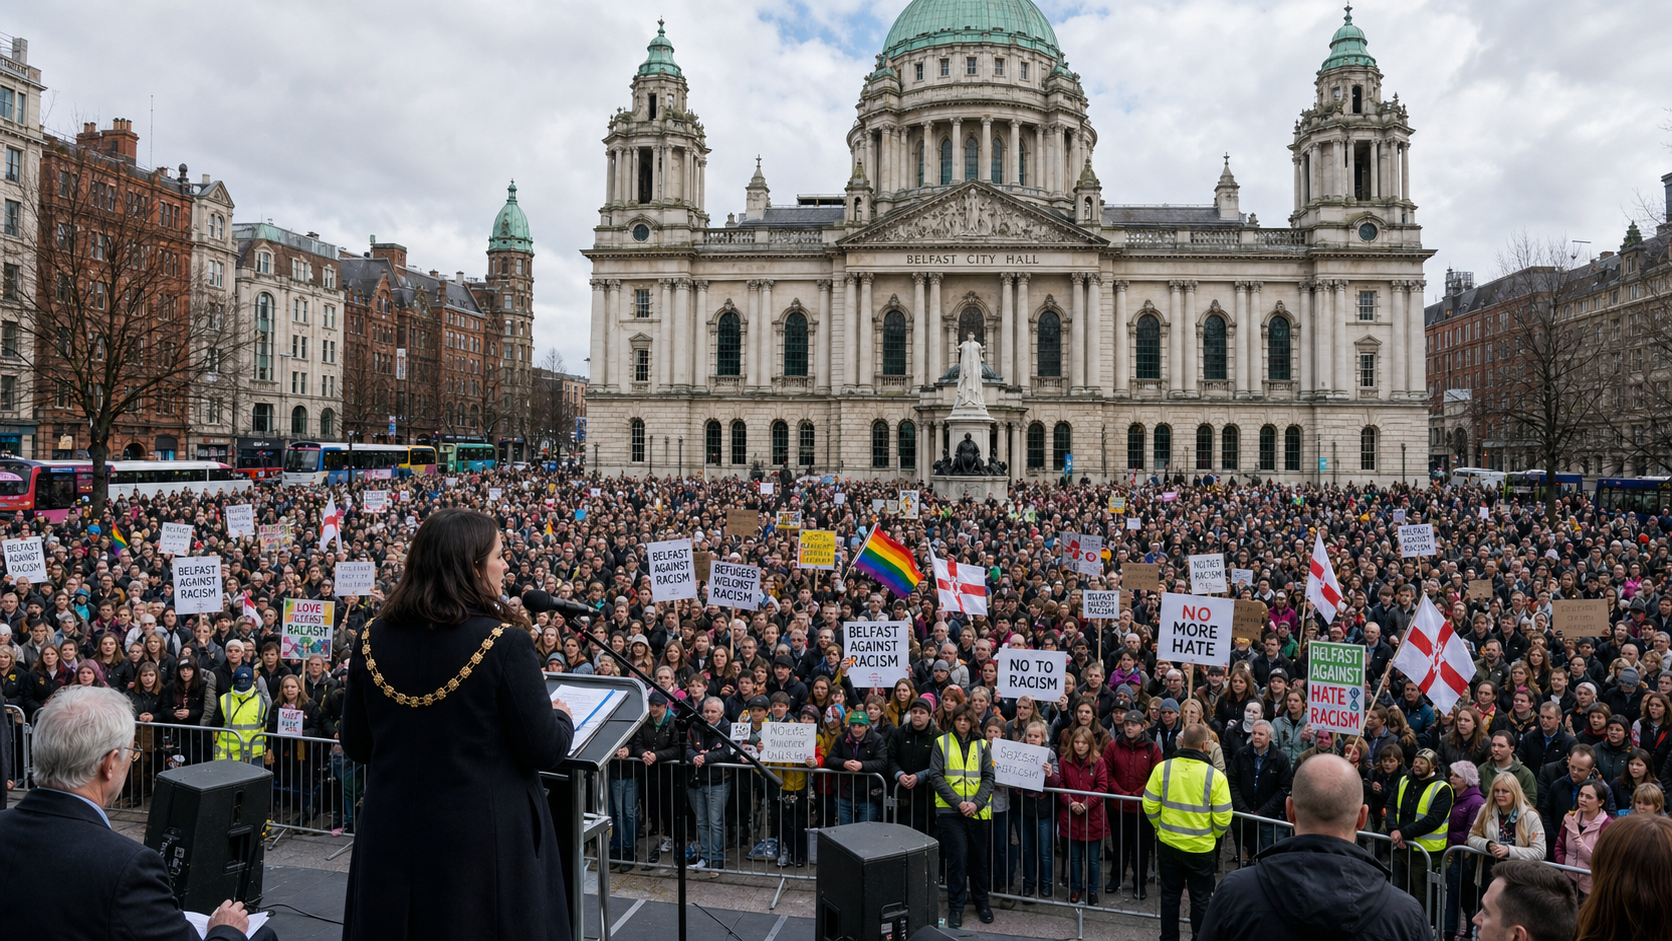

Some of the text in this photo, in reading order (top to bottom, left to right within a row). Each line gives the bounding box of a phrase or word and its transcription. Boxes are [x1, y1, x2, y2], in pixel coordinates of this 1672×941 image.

[906, 254, 1039, 264] BELFAST CITY HALL
[652, 548, 689, 562] BELFAST
[178, 565, 216, 576] BELFAST
[654, 560, 689, 573] AGAINST
[179, 576, 216, 587] AGAINST
[656, 572, 690, 585] RACISM
[180, 588, 216, 599] RACISM
[713, 587, 752, 603] RACISM
[296, 602, 322, 614] LOVE
[1182, 604, 1211, 622] NO
[848, 626, 899, 638] BELFAST
[1173, 620, 1218, 640] MORE
[849, 640, 898, 652] AGAINST
[1172, 638, 1216, 657] HATE
[850, 654, 898, 668] RACISM
[1009, 658, 1053, 673] NO TO
[1312, 663, 1361, 684] AGAINST
[1009, 674, 1058, 690] RACISM
[1311, 684, 1346, 706] HATE
[1311, 707, 1359, 730] RACISM
